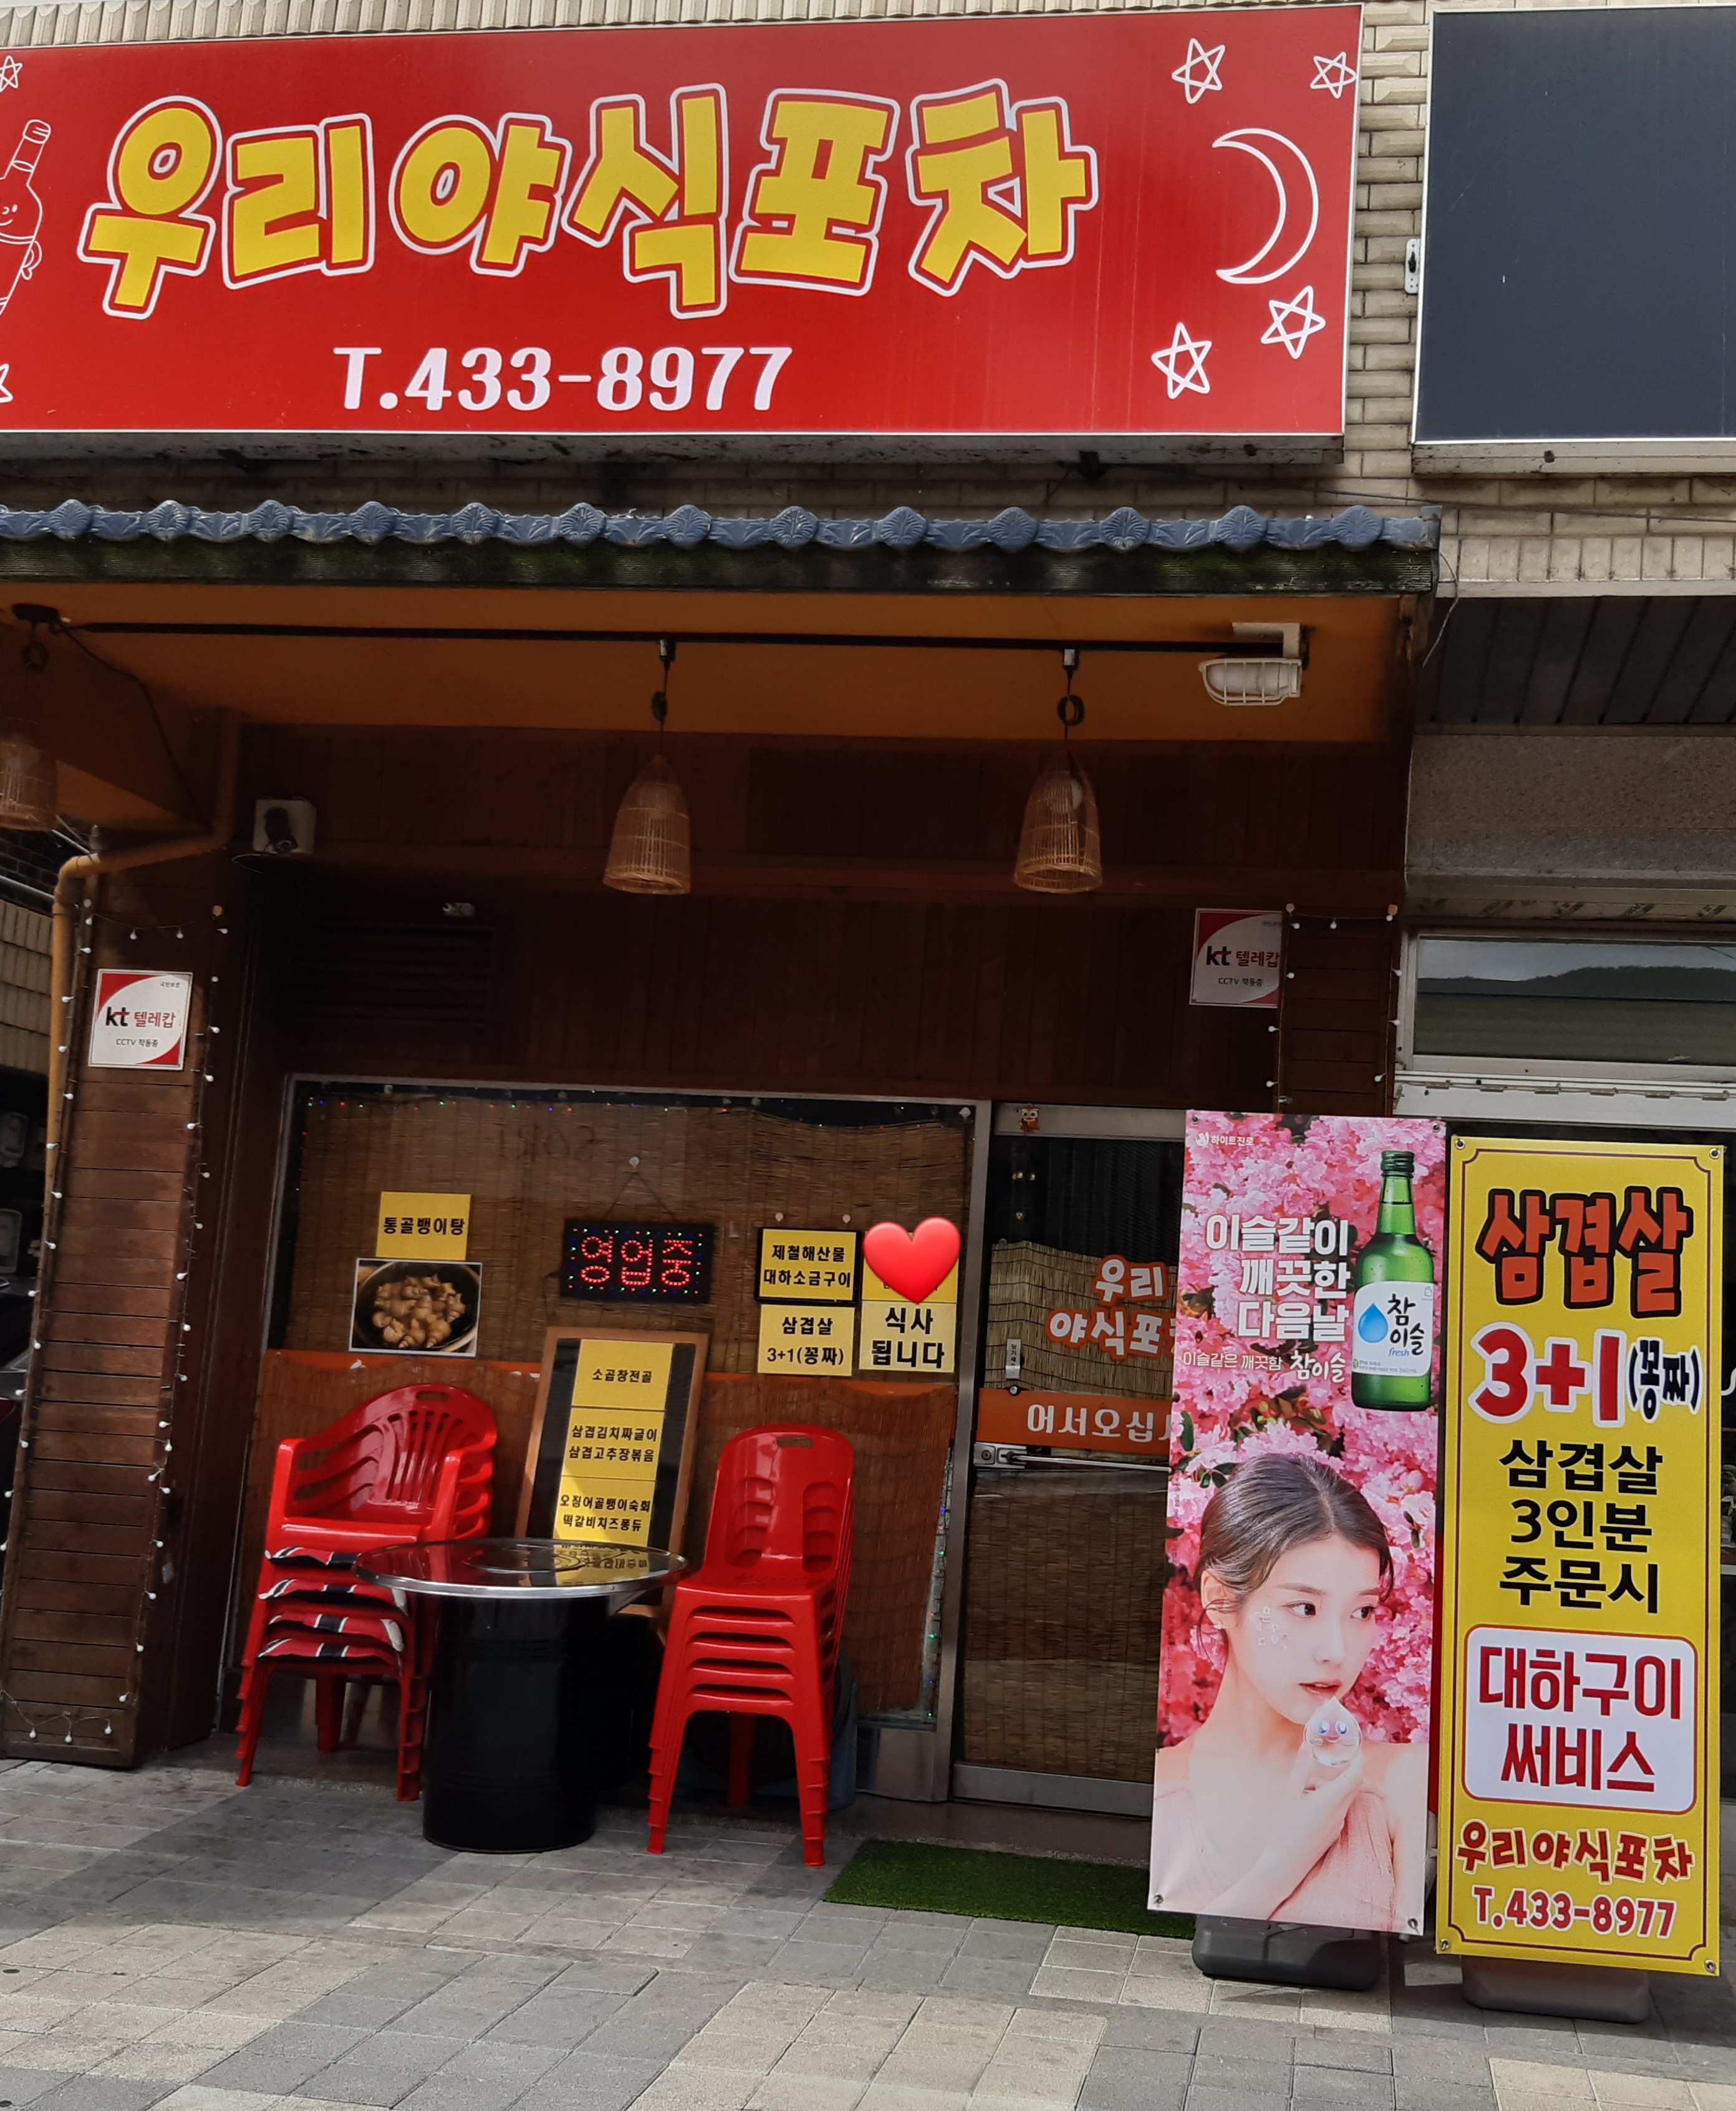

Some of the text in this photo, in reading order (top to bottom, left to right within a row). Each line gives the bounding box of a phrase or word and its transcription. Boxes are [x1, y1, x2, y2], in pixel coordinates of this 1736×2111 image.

[334, 347, 793, 411] T.433-8977
[1206, 946, 1280, 968] kt 텔레캅
[1218, 977, 1239, 985] CCTV
[105, 1006, 176, 1028] kt 텔레캅
[116, 1038, 158, 1048] CCTV 작동중
[1211, 1135, 1254, 1147] 하이트진로
[383, 1216, 465, 1236] 통골뱅이탕
[1206, 1214, 1349, 1256] 이슬같이
[581, 1235, 693, 1286] 영업중
[772, 1244, 845, 1262] 제철해산물
[1475, 1186, 1693, 1319] 삼겹살
[764, 1269, 851, 1288] 대하소금구이
[1096, 1259, 1164, 1302] 우리
[1240, 1259, 1351, 1300] 깨끗한
[782, 1317, 833, 1335] 삼겹살
[885, 1307, 933, 1335] 식사
[1238, 1301, 1349, 1342] 다음날
[871, 1339, 945, 1369] 됩니다
[1183, 1351, 1238, 1368] 이슬같은
[1241, 1355, 1283, 1371] 깨끗함
[1290, 1350, 1346, 1383] 참이슬
[1388, 1347, 1409, 1357] fresh
[592, 1368, 652, 1384] 소곱창전골
[572, 1425, 658, 1442] 삼겹김치짜글이
[569, 1446, 655, 1463] 삼겹고추장볶음
[1499, 1440, 1663, 1495] 삼겹살
[559, 1494, 650, 1512] 오징어골뱅이숙회
[563, 1514, 642, 1532] 떡갈비치즈퐁듀
[1510, 1499, 1652, 1552] 3인분
[1500, 1556, 1658, 1614] 주문시
[1479, 1645, 1681, 1720] 대하구이
[1500, 1723, 1655, 1792] 써비스
[1456, 1819, 1695, 1884] 우리야식포차
[1472, 1885, 1676, 1938] T.433-8977
